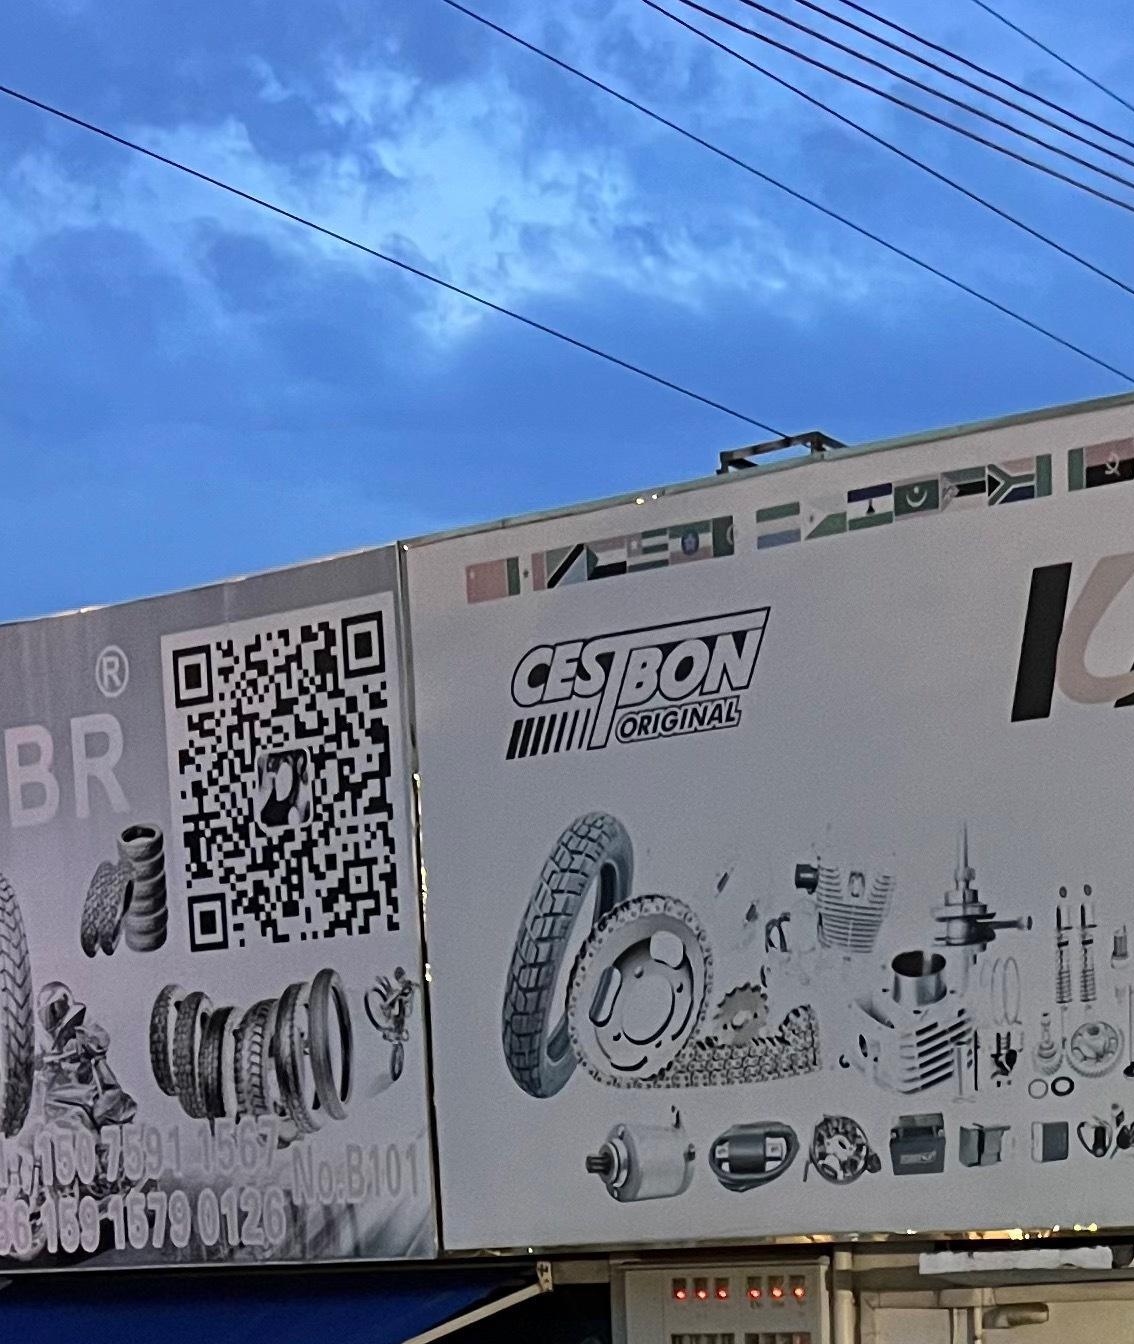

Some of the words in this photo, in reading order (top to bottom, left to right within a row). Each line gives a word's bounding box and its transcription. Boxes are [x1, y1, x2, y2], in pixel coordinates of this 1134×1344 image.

[511, 606, 771, 750] CESTBON
[617, 702, 739, 741] ORIGINAL
[198, 1187, 287, 1246] 0126
